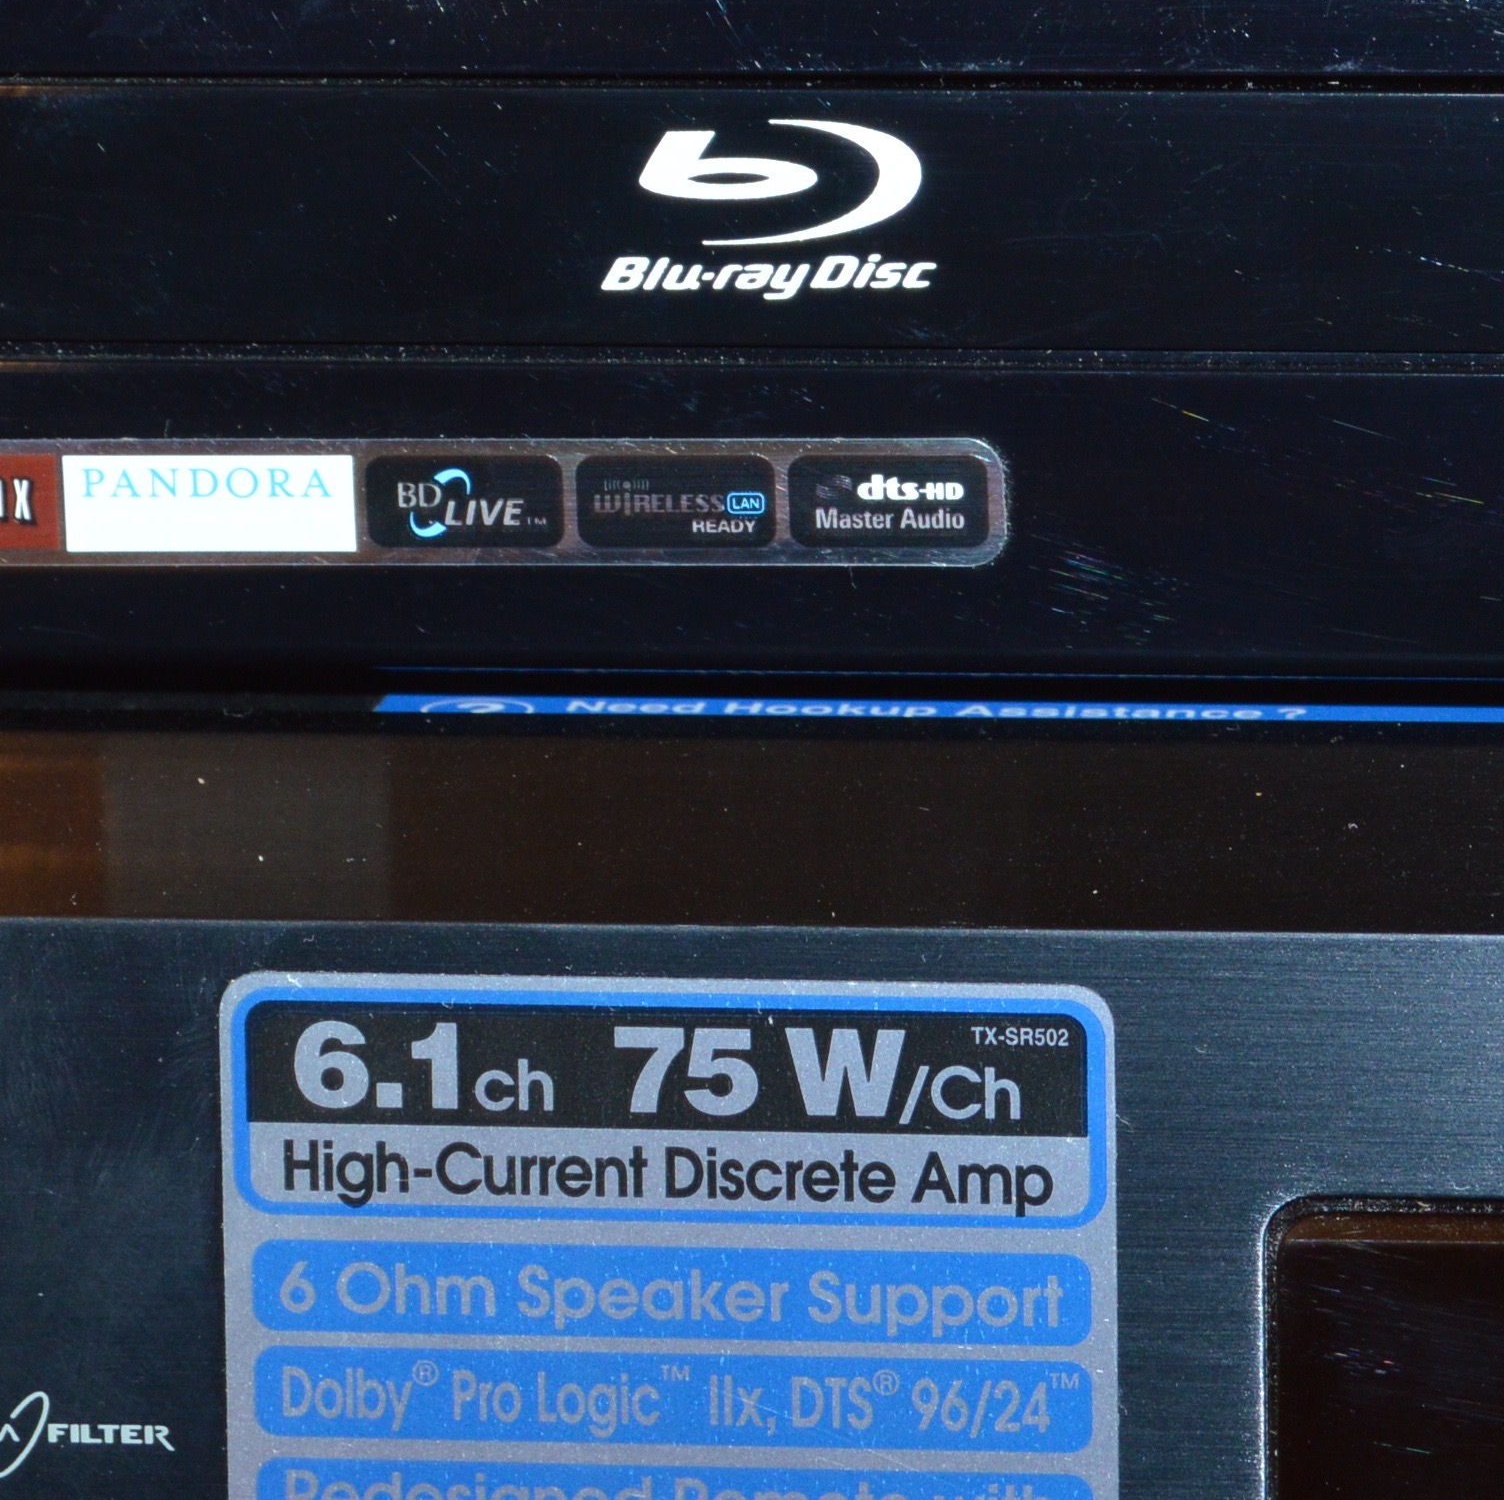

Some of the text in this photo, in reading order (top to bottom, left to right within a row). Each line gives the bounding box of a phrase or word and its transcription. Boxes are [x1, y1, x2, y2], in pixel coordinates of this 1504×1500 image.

[600, 254, 937, 300] Blu-ray Disc
[82, 468, 333, 499] PANDORA
[397, 482, 441, 508] BD
[857, 474, 964, 500] dts-HD
[732, 498, 760, 510] LAN
[692, 519, 756, 533] READY
[815, 507, 965, 529] Master Audio
[566, 700, 706, 714] Need
[724, 702, 937, 717] Hookup
[956, 704, 1263, 720] Assistance
[971, 1025, 1070, 1049] TX-SR502
[614, 1026, 759, 1117] 75
[284, 1139, 1054, 1218] High-Current Discrete Amp
[280, 1261, 1064, 1336] 6 Ohm Speaker Support
[453, 1369, 522, 1422] Pro
[48, 1423, 175, 1451] FILTER
